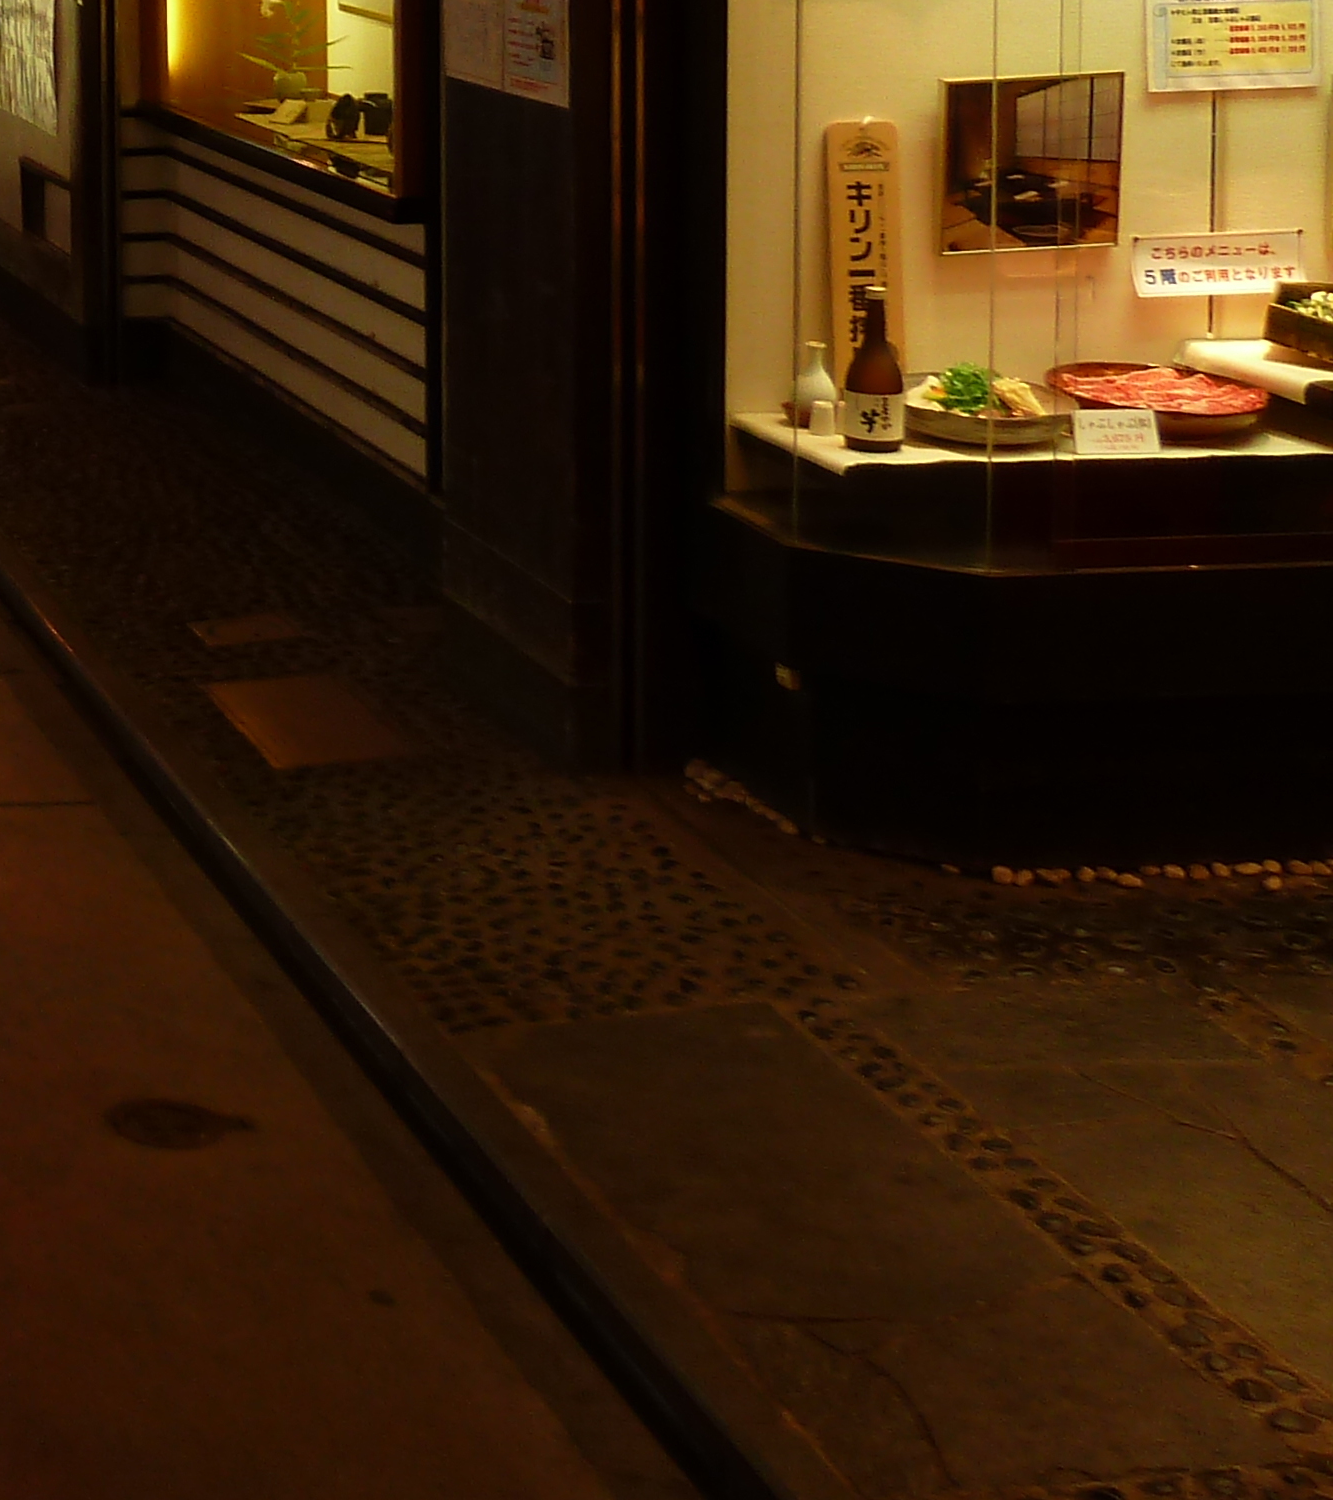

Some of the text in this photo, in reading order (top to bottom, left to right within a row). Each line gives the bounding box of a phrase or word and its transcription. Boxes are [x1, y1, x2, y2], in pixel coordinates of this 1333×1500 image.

[1150, 241, 1278, 260] こちらのメニューは、
[1143, 265, 1296, 286] 5階のご利用となります
